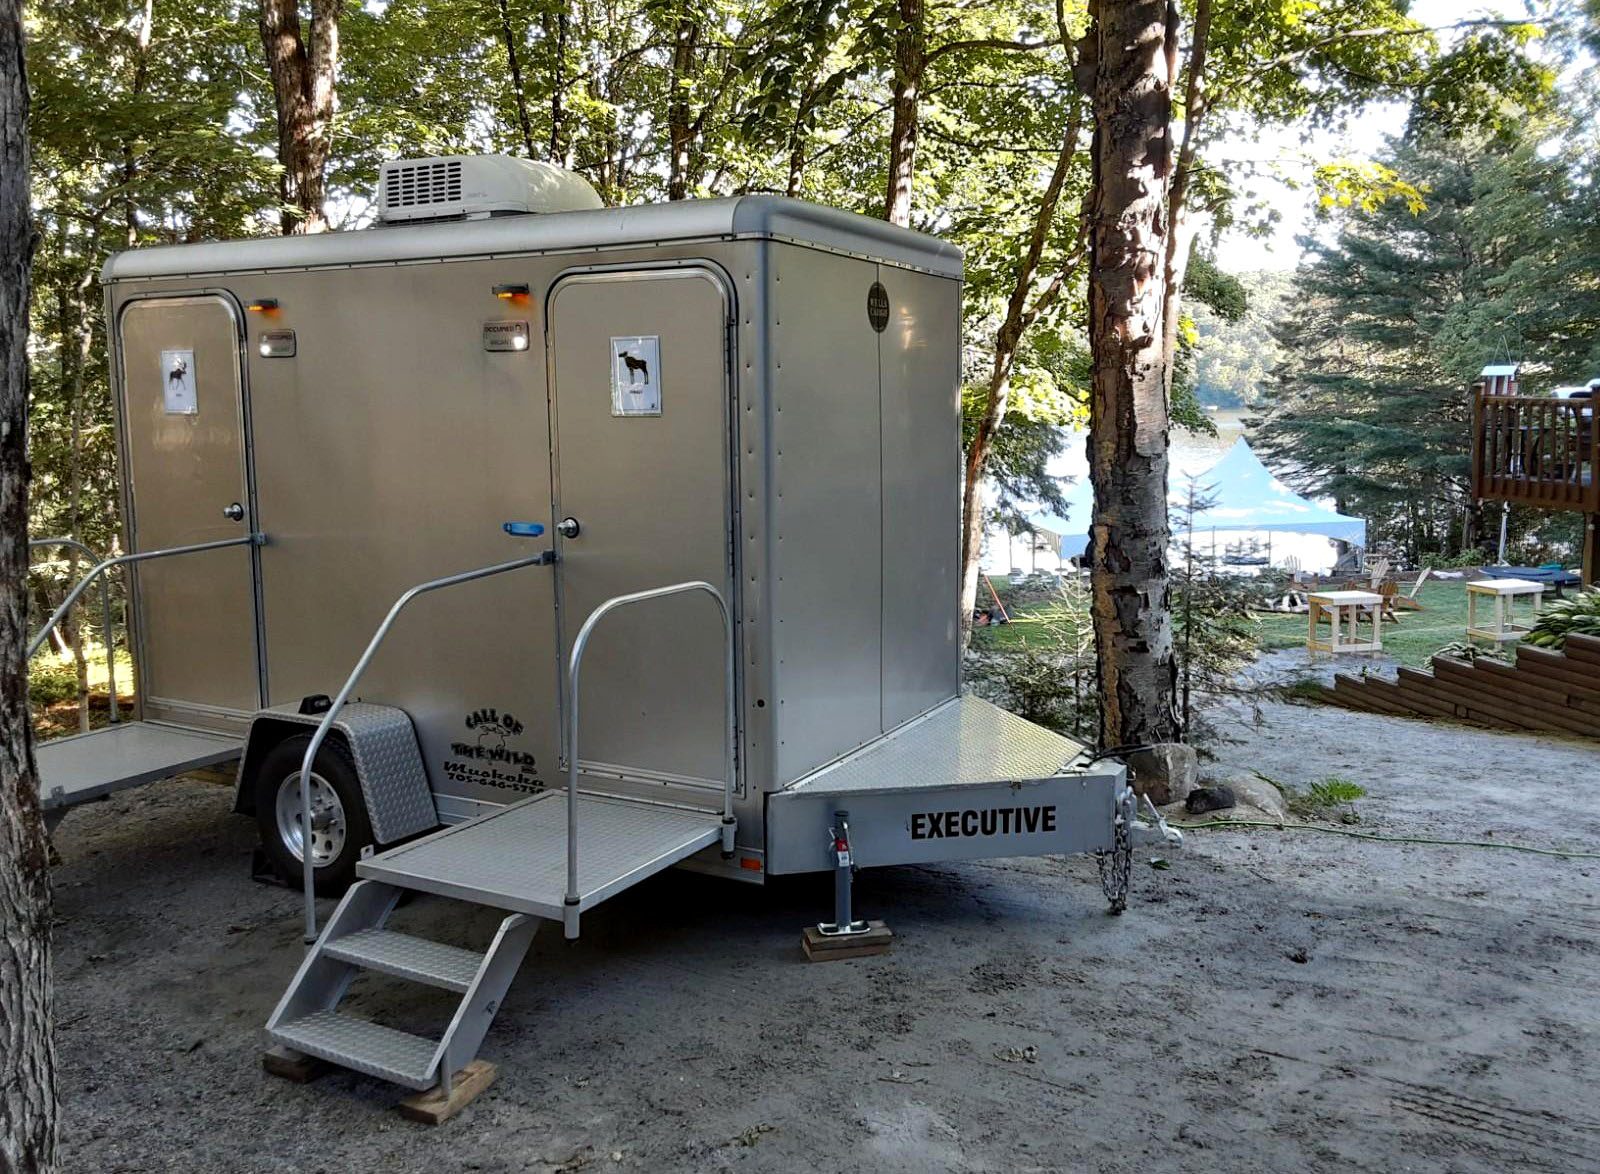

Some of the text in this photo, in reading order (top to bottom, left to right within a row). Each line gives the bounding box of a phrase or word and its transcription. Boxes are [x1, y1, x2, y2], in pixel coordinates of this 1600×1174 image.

[465, 708, 525, 736] CALL OF
[451, 743, 536, 766] THE WILD
[911, 805, 1056, 840] EXECUTIVE
